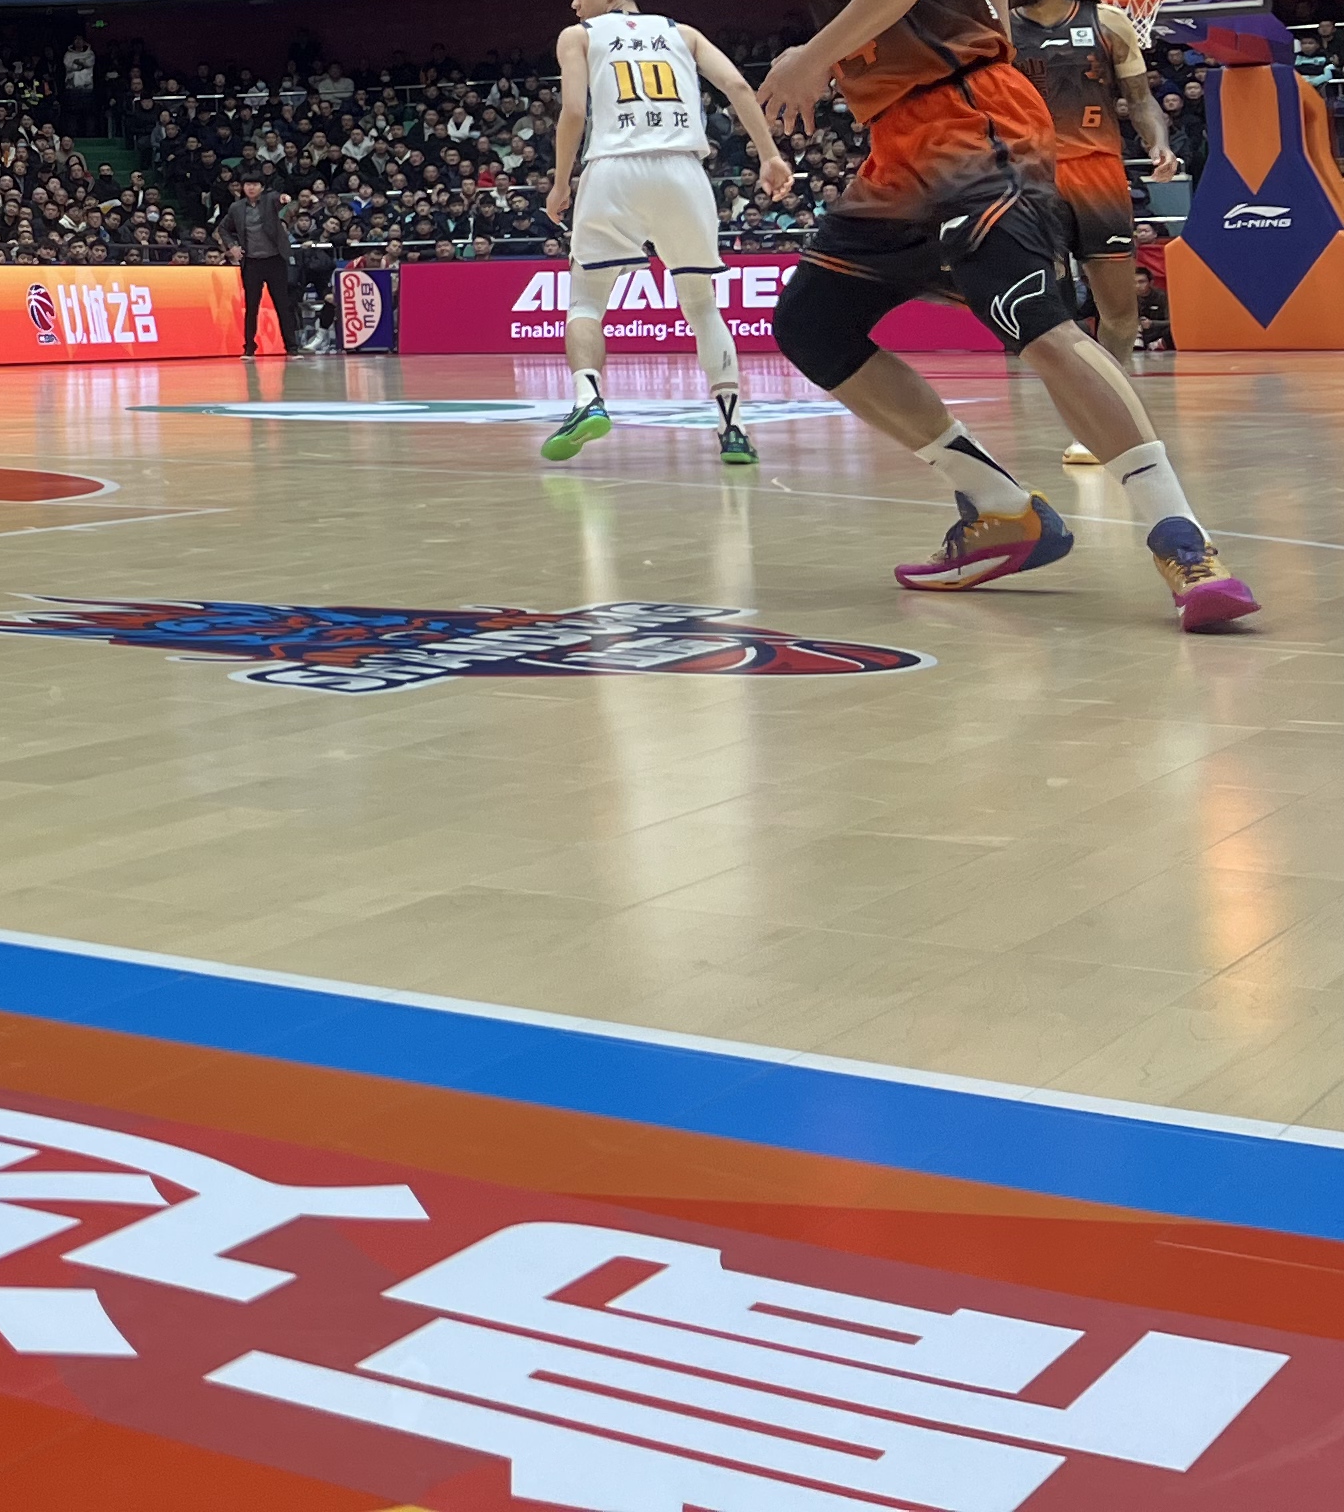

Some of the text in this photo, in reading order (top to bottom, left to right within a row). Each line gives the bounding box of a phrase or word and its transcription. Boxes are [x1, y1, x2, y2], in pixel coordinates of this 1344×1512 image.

[609, 59, 684, 105] 10
[1082, 105, 1103, 128] 6
[1223, 217, 1292, 229] LI-NING
[58, 281, 159, 345] 以城之名
[360, 281, 377, 330] 百岁山
[510, 320, 696, 341] Enabli eading-E
